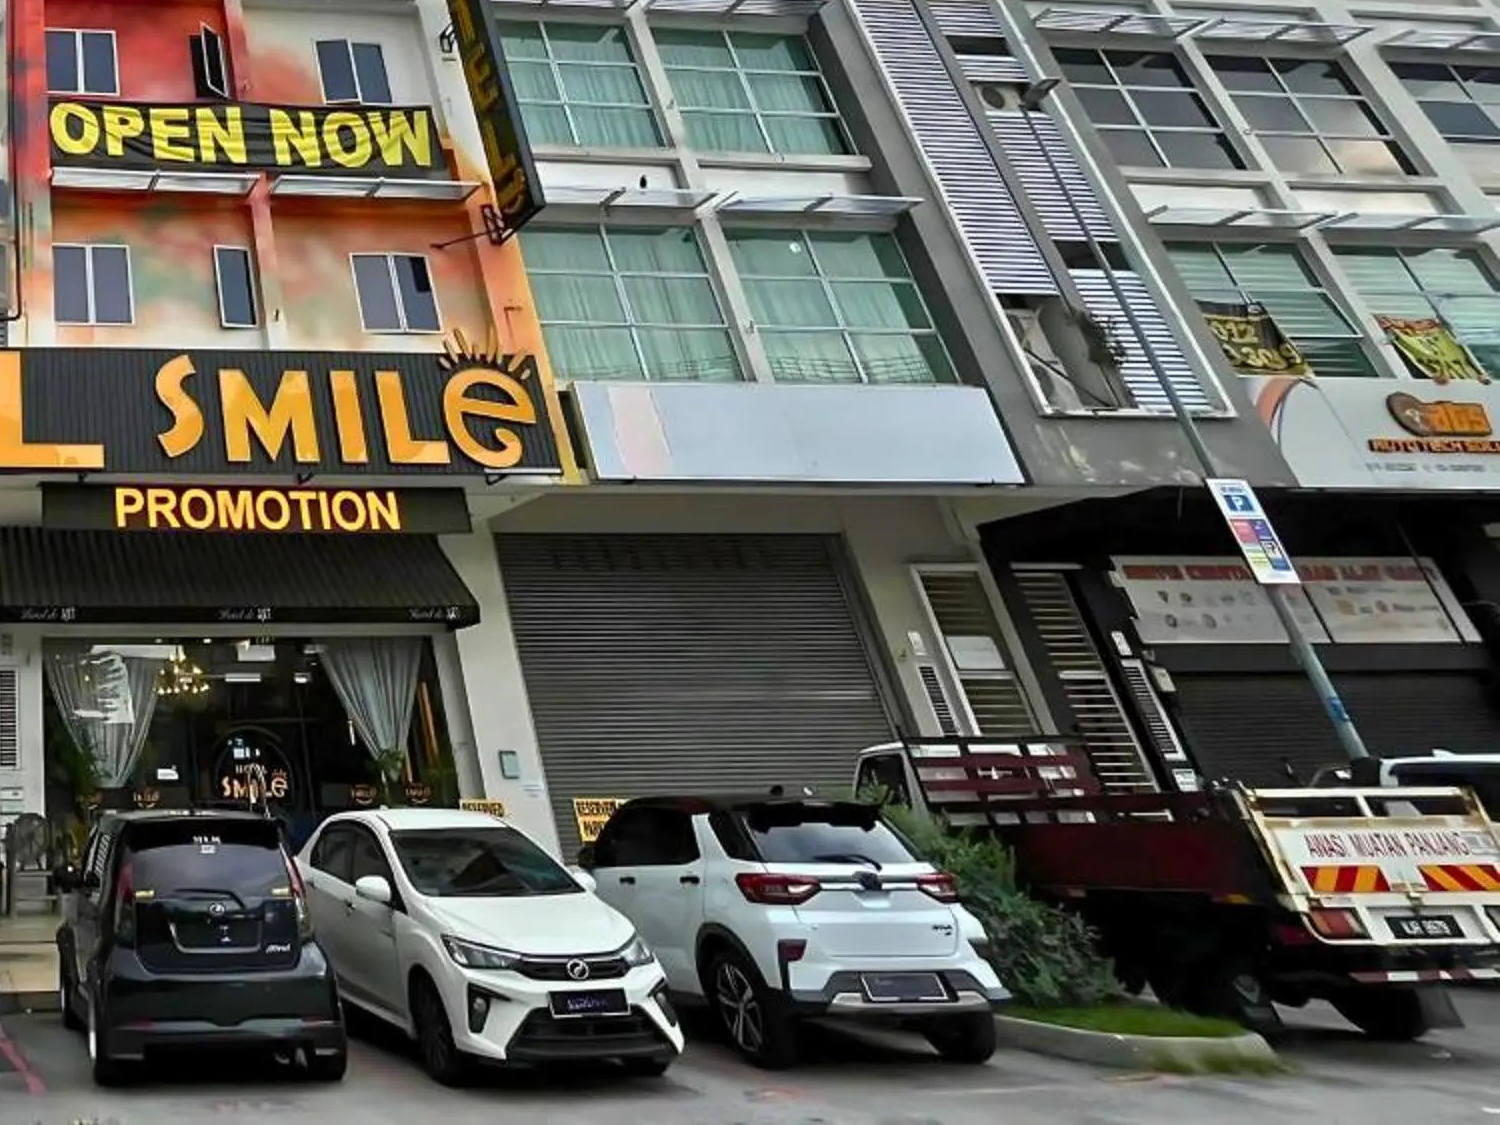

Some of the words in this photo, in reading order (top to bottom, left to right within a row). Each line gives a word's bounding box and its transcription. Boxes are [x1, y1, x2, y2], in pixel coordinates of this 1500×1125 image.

[50, 102, 247, 165] OPEN
[269, 108, 431, 168] NOW
[114, 487, 401, 532] PROMOTION
[1349, 832, 1408, 858] MUATAN
[1404, 831, 1471, 857] PANJANG
